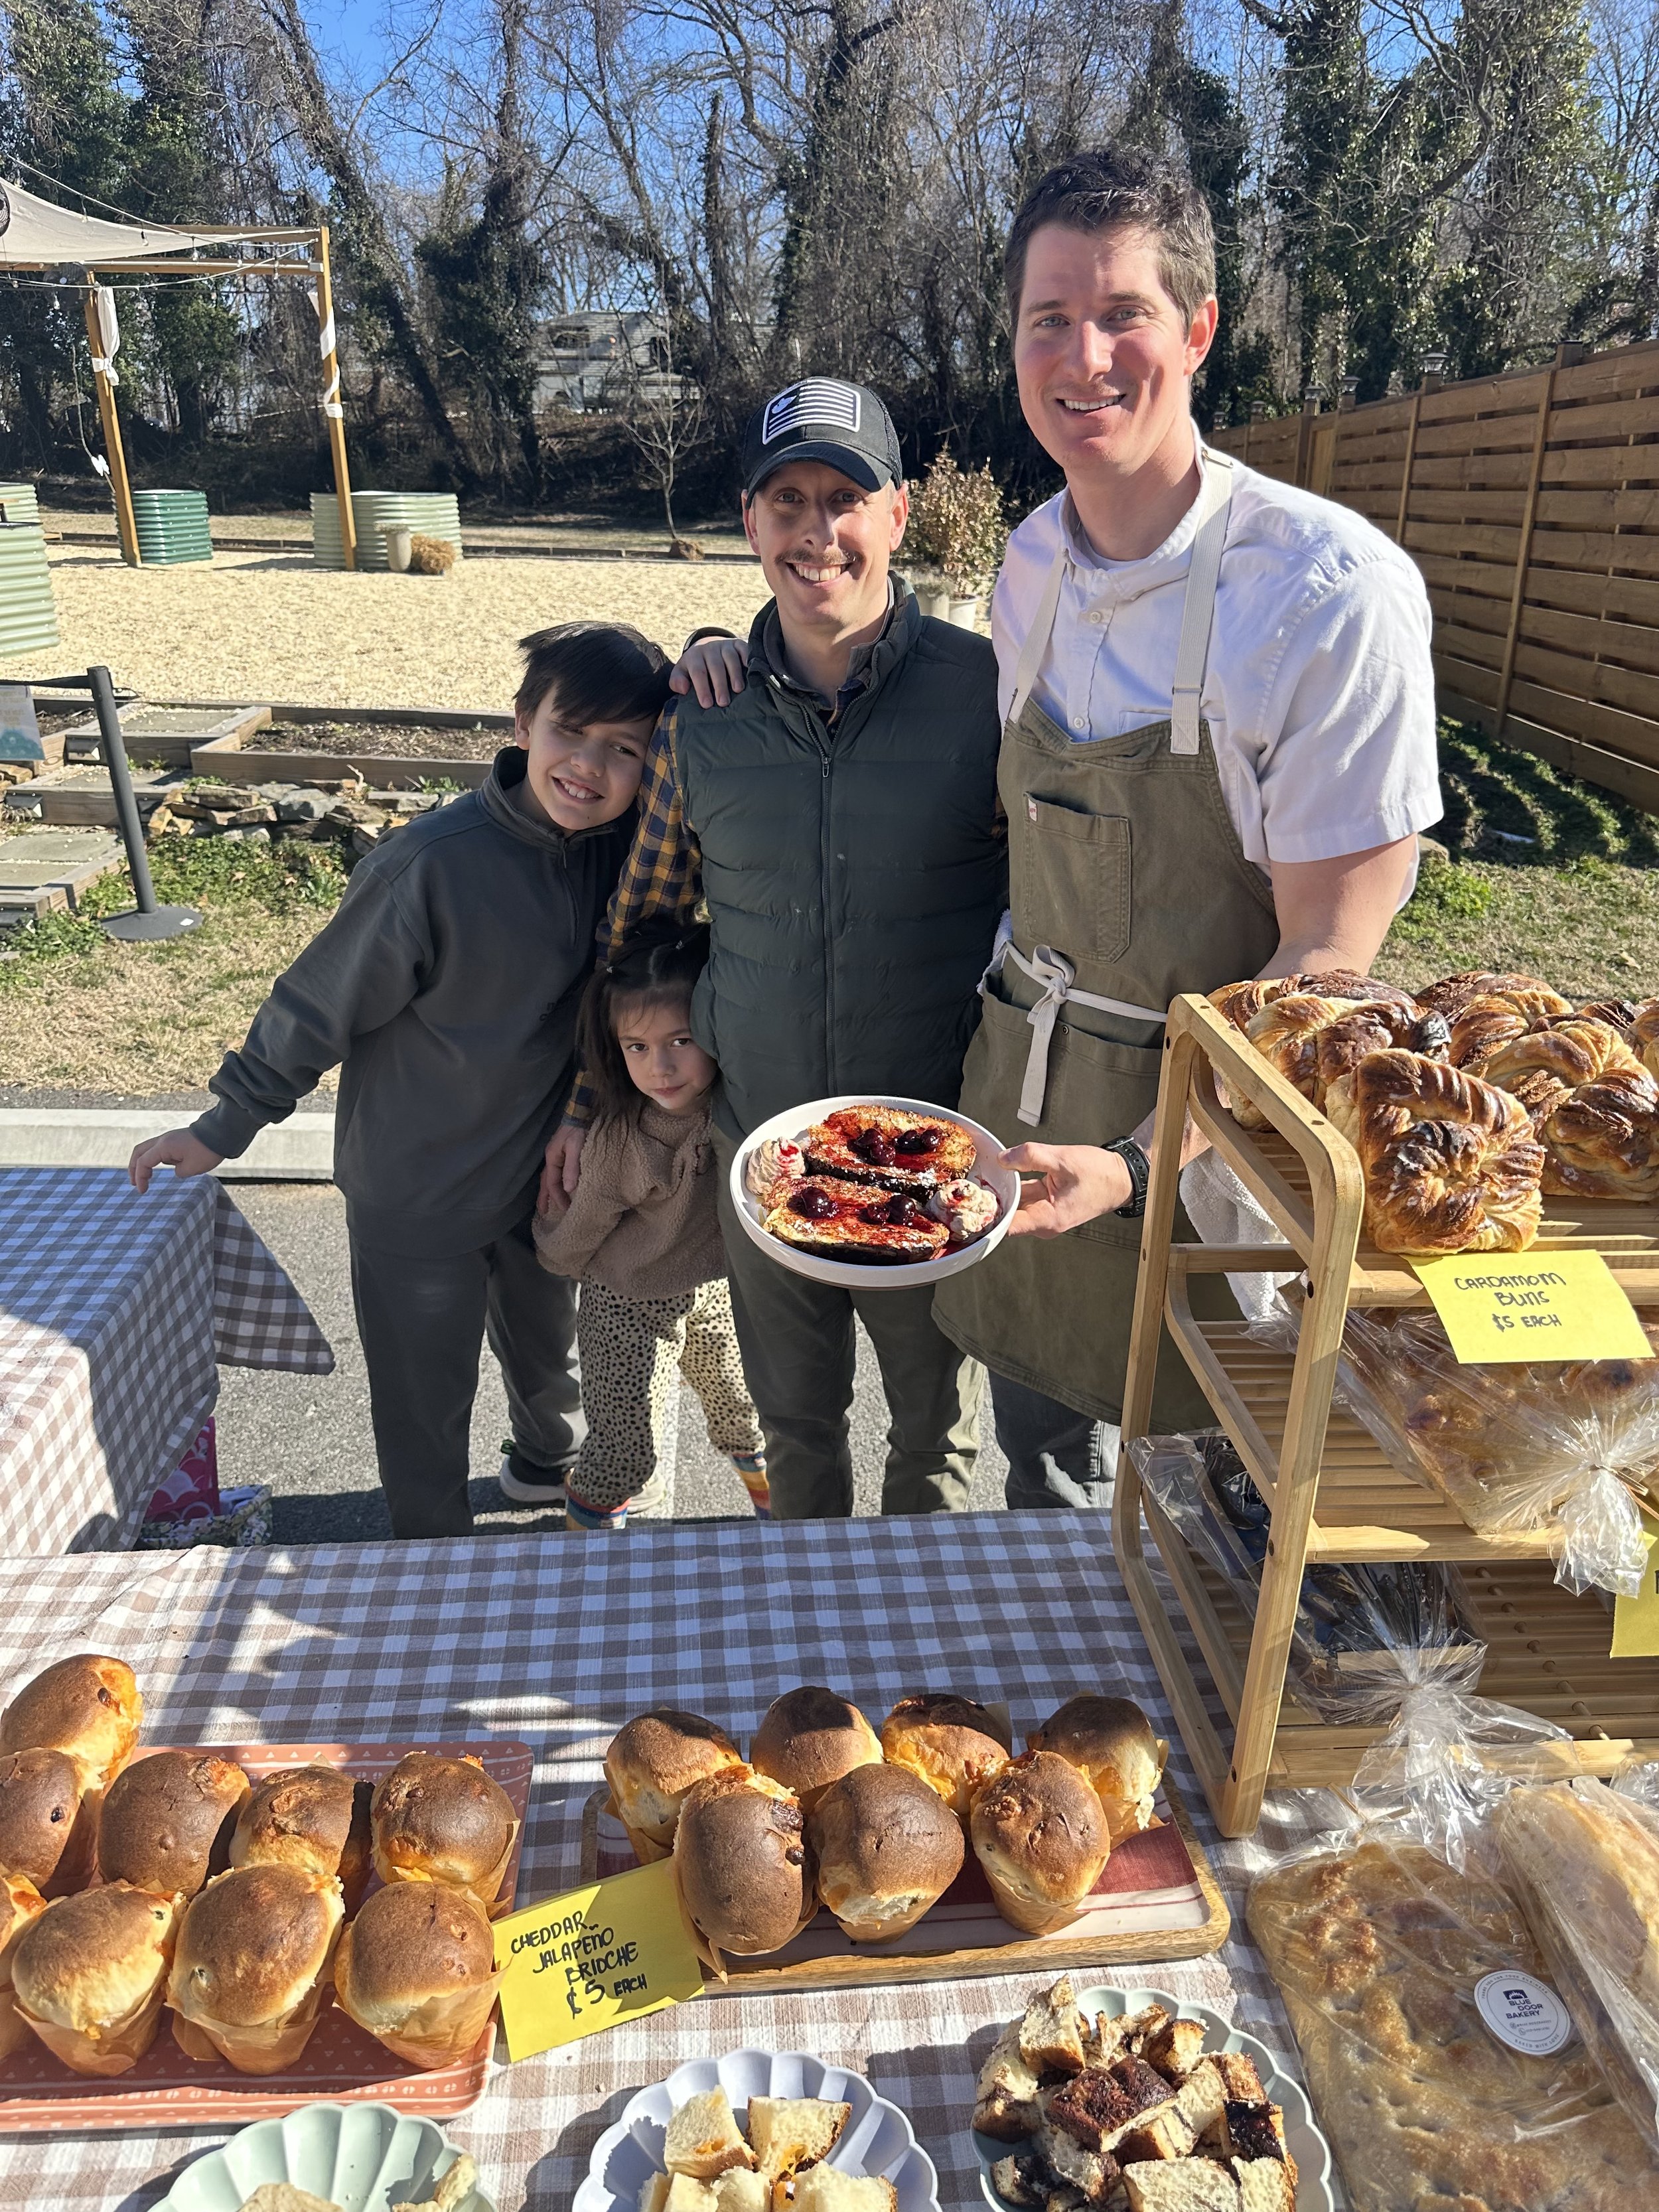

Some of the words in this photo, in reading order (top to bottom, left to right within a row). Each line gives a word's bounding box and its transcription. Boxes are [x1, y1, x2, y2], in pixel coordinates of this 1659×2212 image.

[1454, 1272, 1567, 1290] CARDAMOM
[1494, 1291, 1550, 1307] BUNS
[1491, 1313, 1515, 1333] $5
[1520, 1314, 1562, 1328] EACH
[510, 1910, 588, 1954] CHEDDAR
[532, 1923, 614, 1974] JALAPEÑO
[565, 1941, 639, 1986] BRIOCHE
[613, 1973, 648, 1996] EACH
[1505, 2010, 1540, 2019] BAKERY
